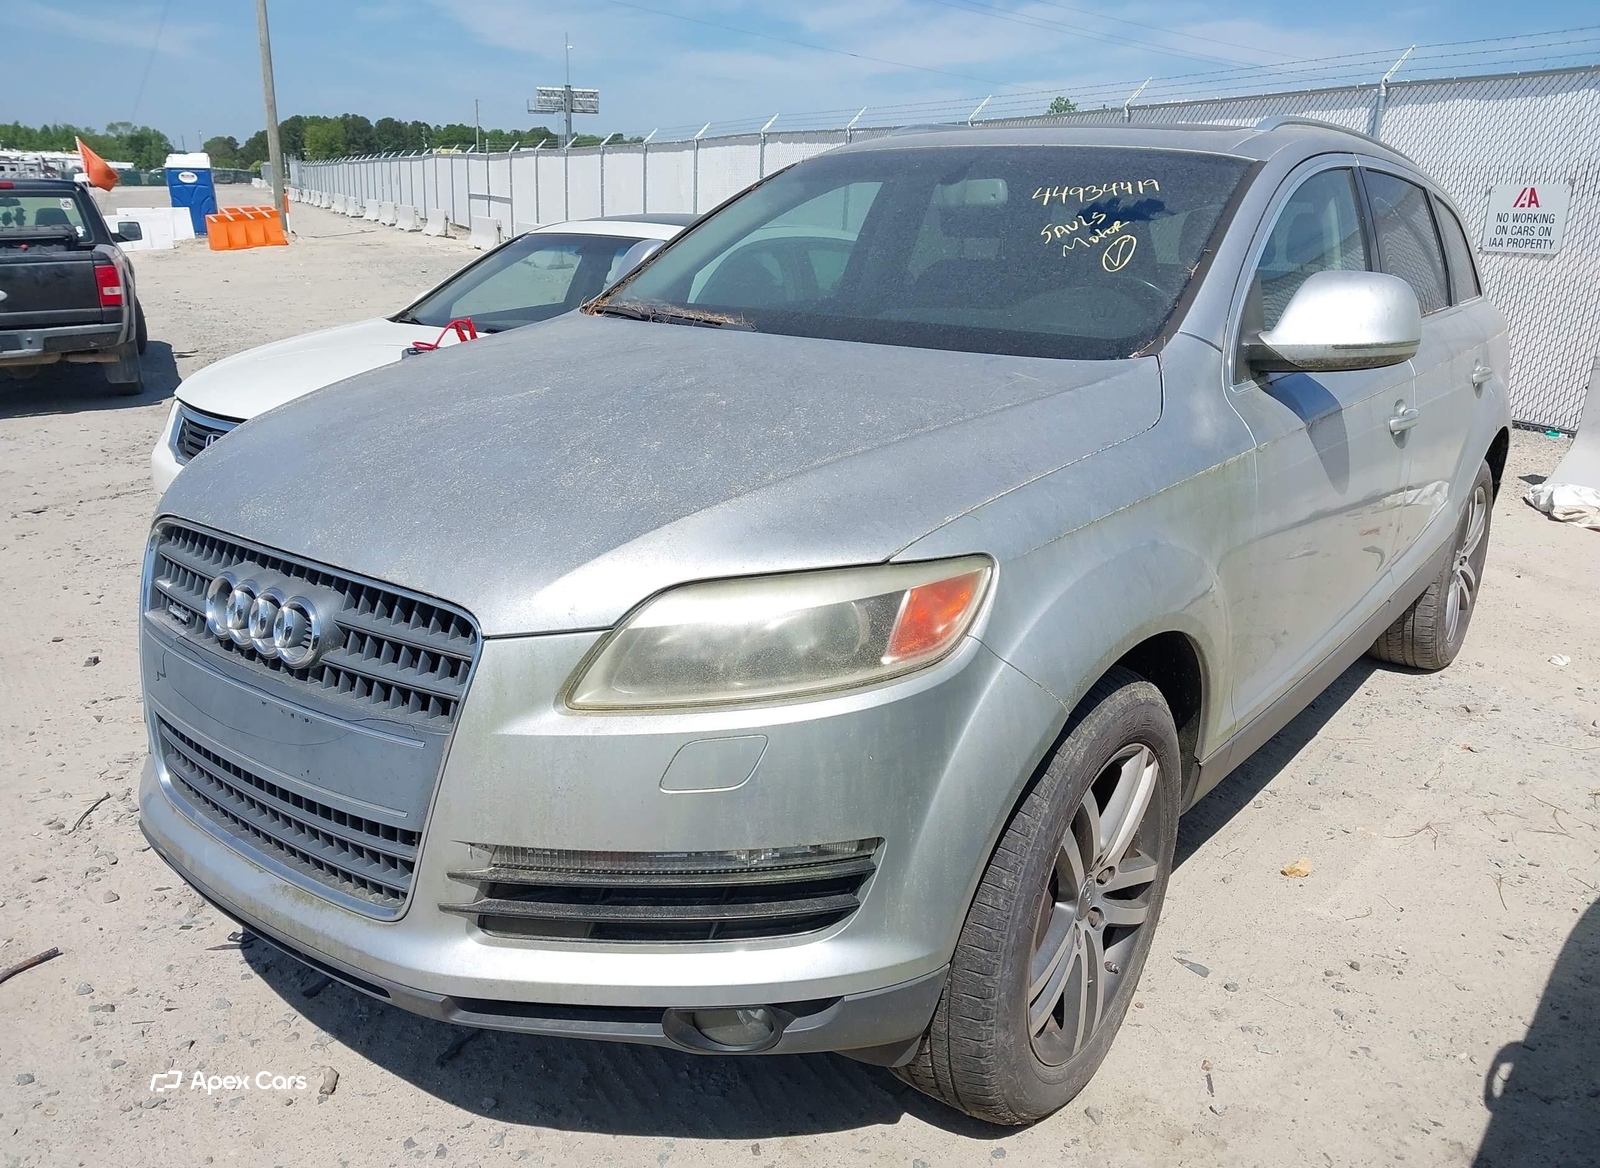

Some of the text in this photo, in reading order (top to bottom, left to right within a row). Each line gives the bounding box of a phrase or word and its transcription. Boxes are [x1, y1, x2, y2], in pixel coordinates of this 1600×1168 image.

[1032, 179, 1160, 205] 44934419
[1496, 213, 1556, 224] NO WORKING
[1495, 225, 1552, 237] ON CARS ON
[1488, 237, 1555, 249] IAA PROPERTY
